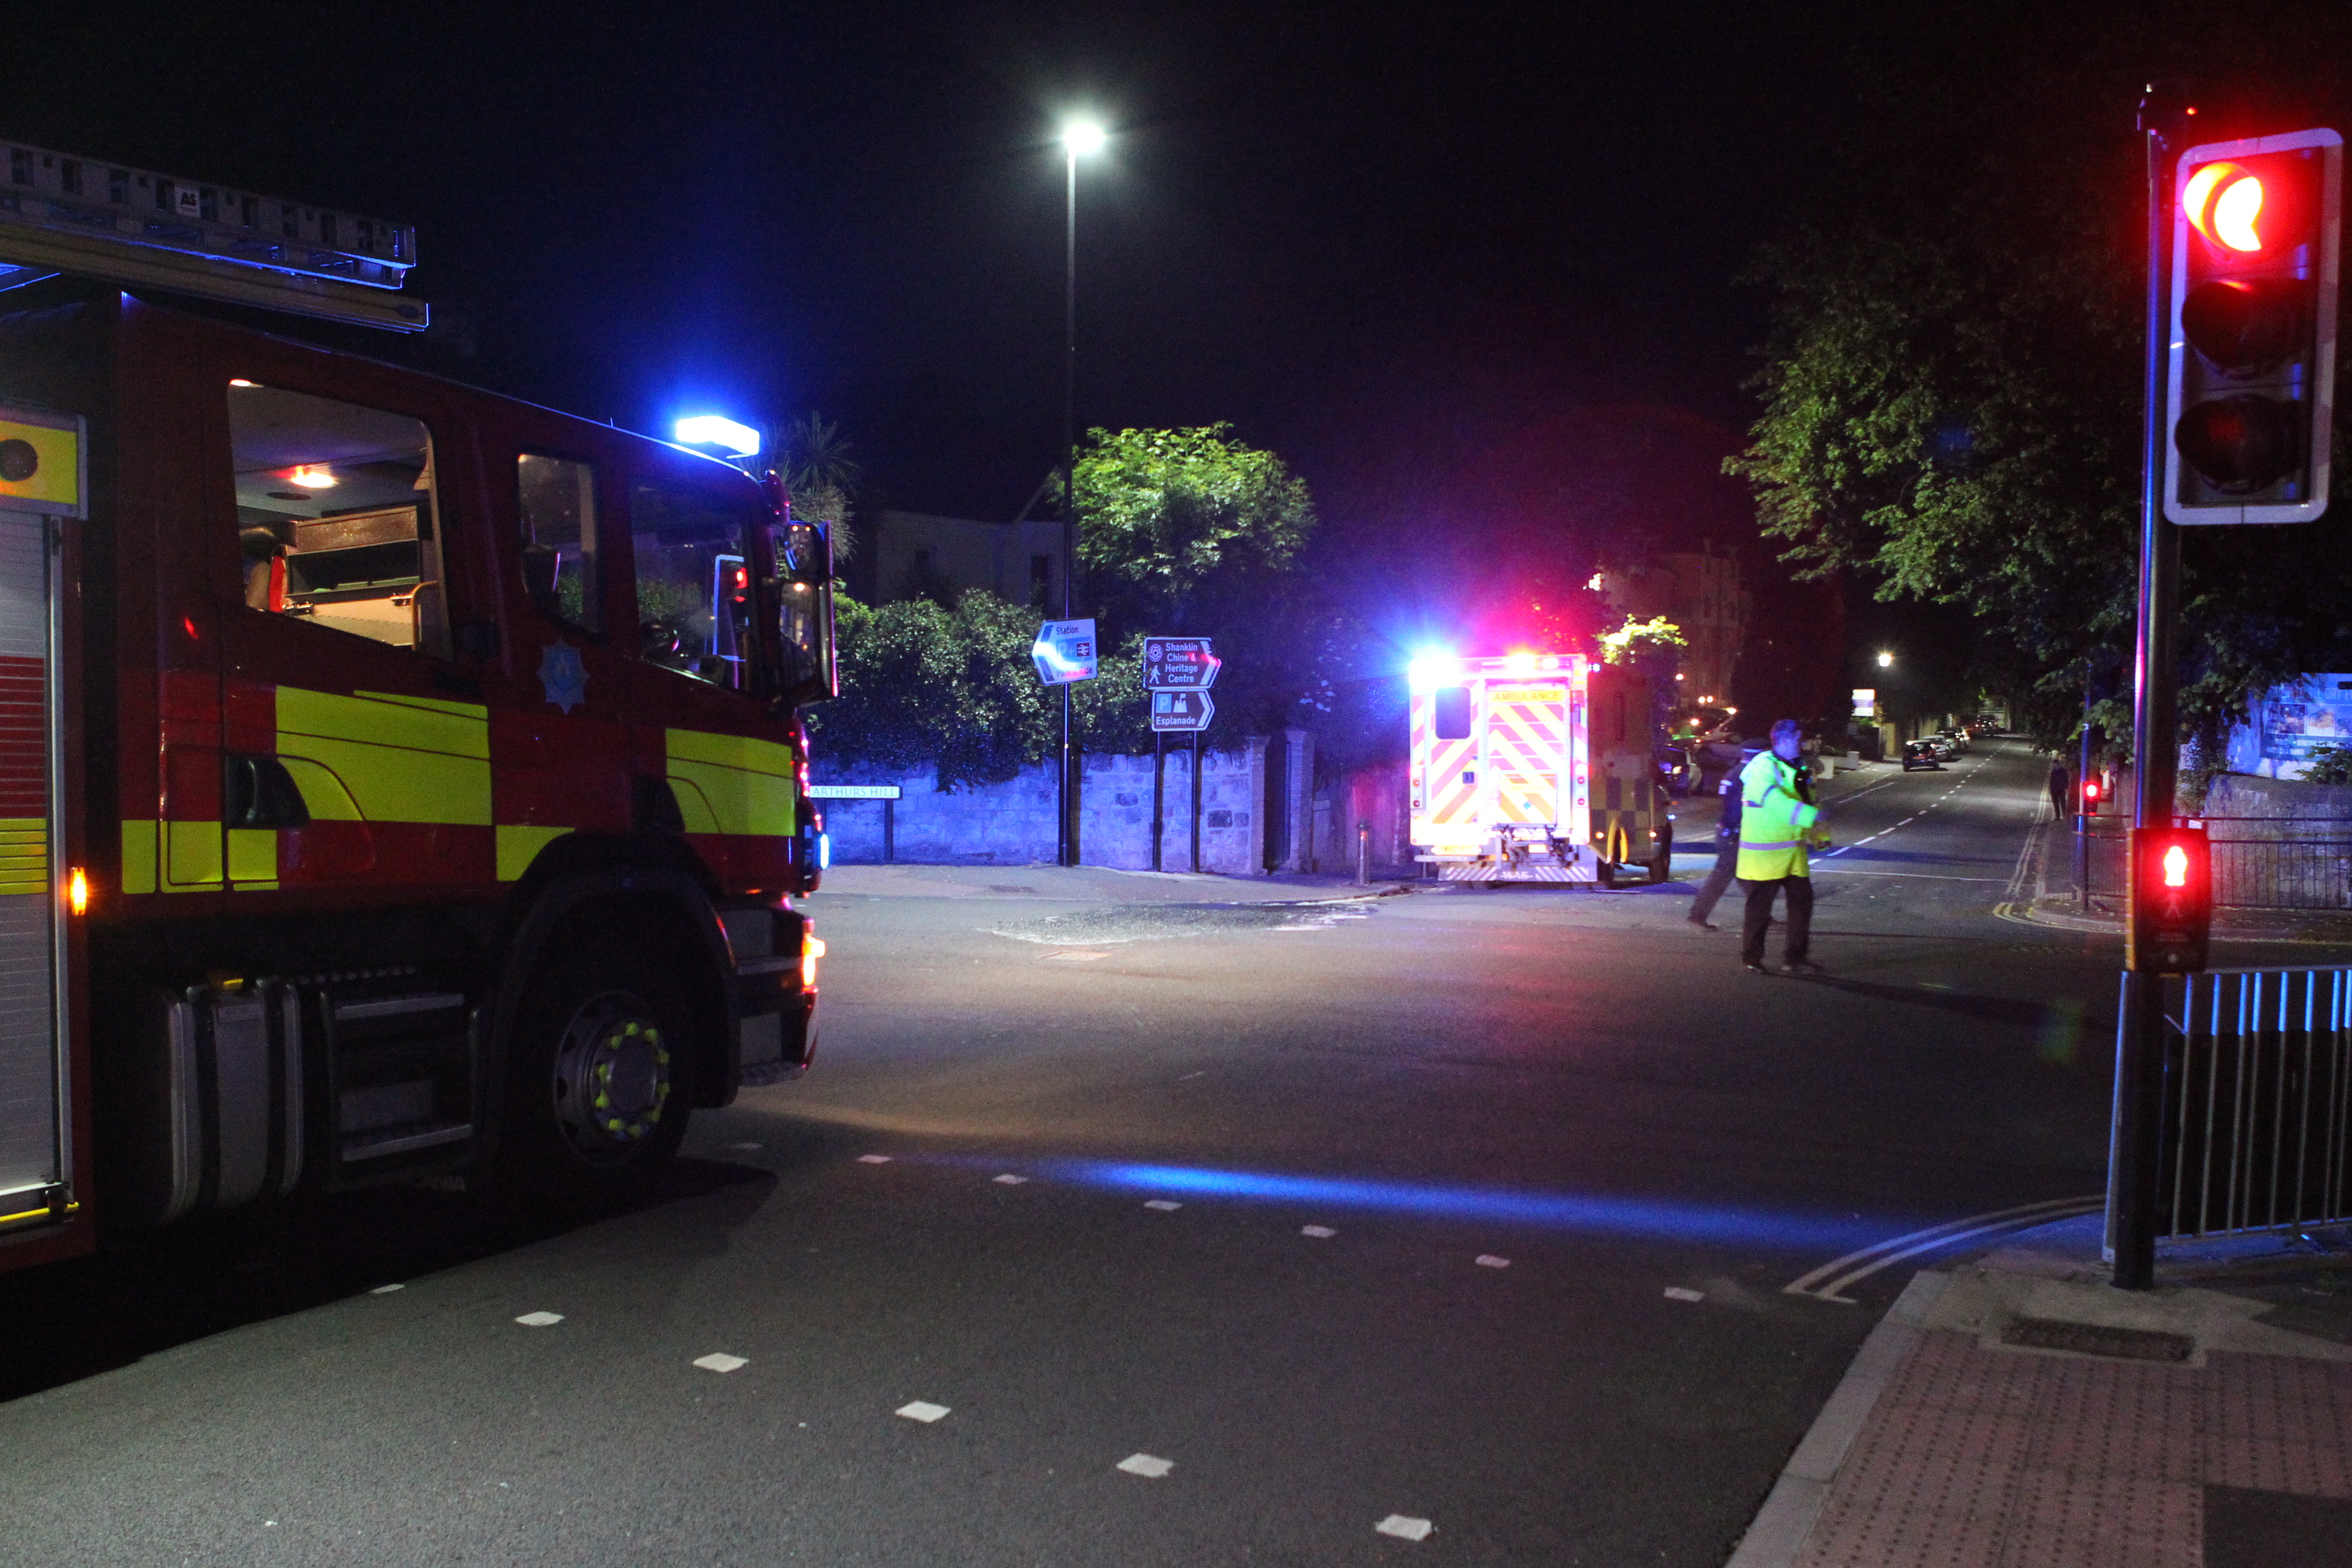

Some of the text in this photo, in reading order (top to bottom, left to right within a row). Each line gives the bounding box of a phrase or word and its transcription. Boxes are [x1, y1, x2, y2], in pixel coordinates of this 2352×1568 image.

[1055, 626, 1079, 635] Station
[1165, 642, 1199, 652] Shanklin
[1166, 653, 1197, 662] Chine &
[1165, 663, 1199, 673] Heritage
[1168, 673, 1195, 683] Centre
[1493, 691, 1561, 701] AMBULANCE
[1159, 696, 1169, 711] P
[1155, 716, 1196, 726] Esplanade
[812, 787, 897, 798] ARTHURS HILL
